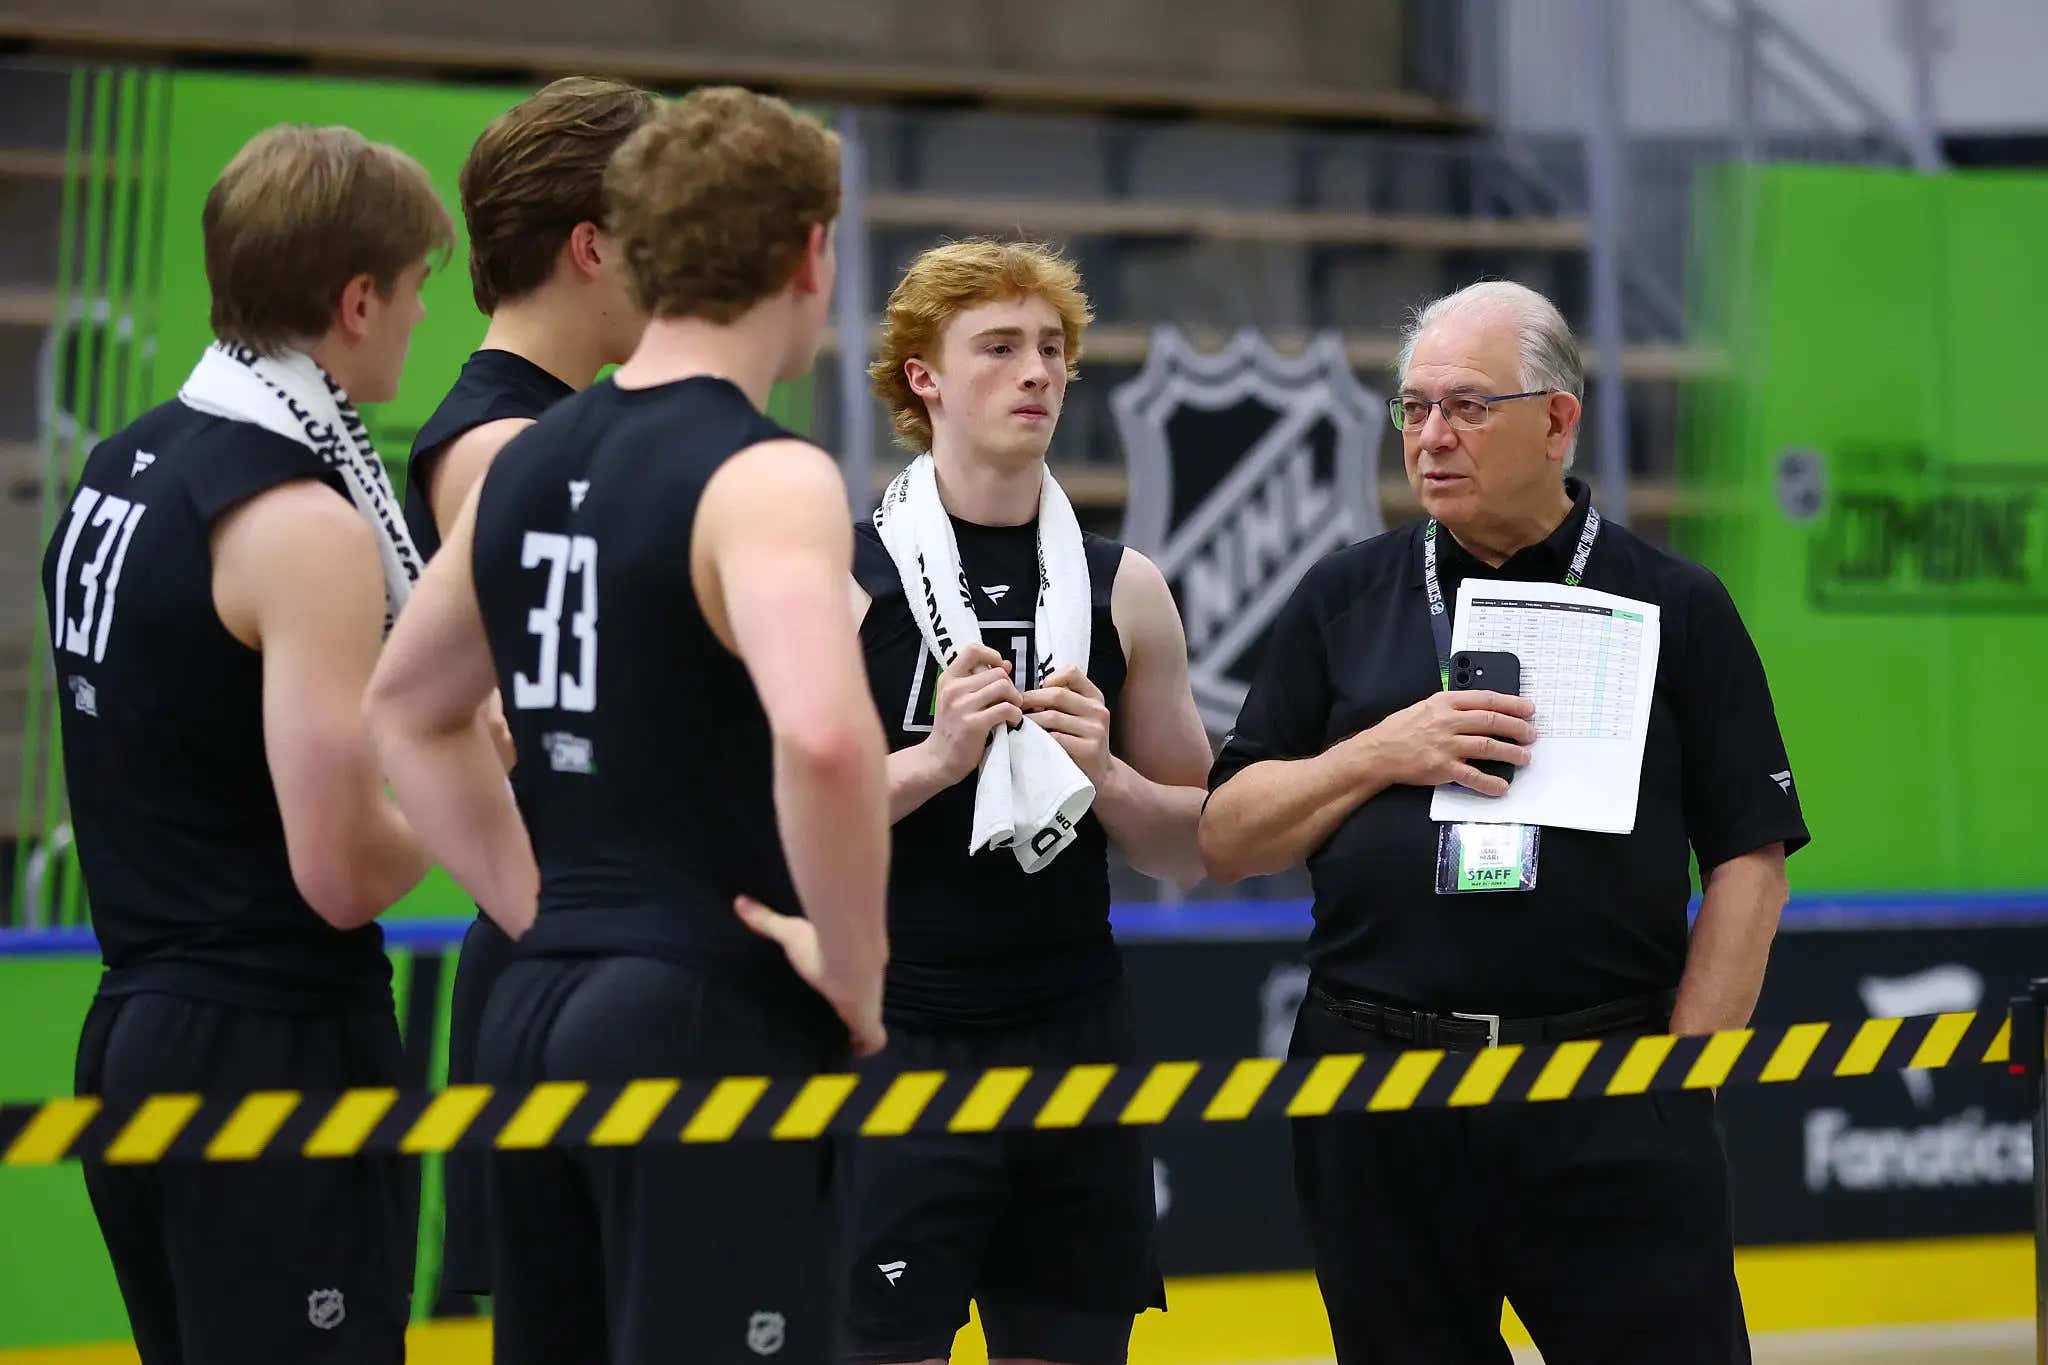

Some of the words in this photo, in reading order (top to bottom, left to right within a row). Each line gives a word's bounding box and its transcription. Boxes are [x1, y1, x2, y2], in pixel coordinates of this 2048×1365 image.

[1182, 444, 1334, 652] NHL
[1580, 513, 1600, 548] SCOUTING
[1424, 537, 1438, 570] COMBINE
[1569, 540, 1592, 577] COMBINE
[54, 486, 146, 664] 131
[1426, 568, 1442, 604] SCOUTING
[513, 530, 599, 713] 33
[1467, 868, 1512, 881] STAFF
